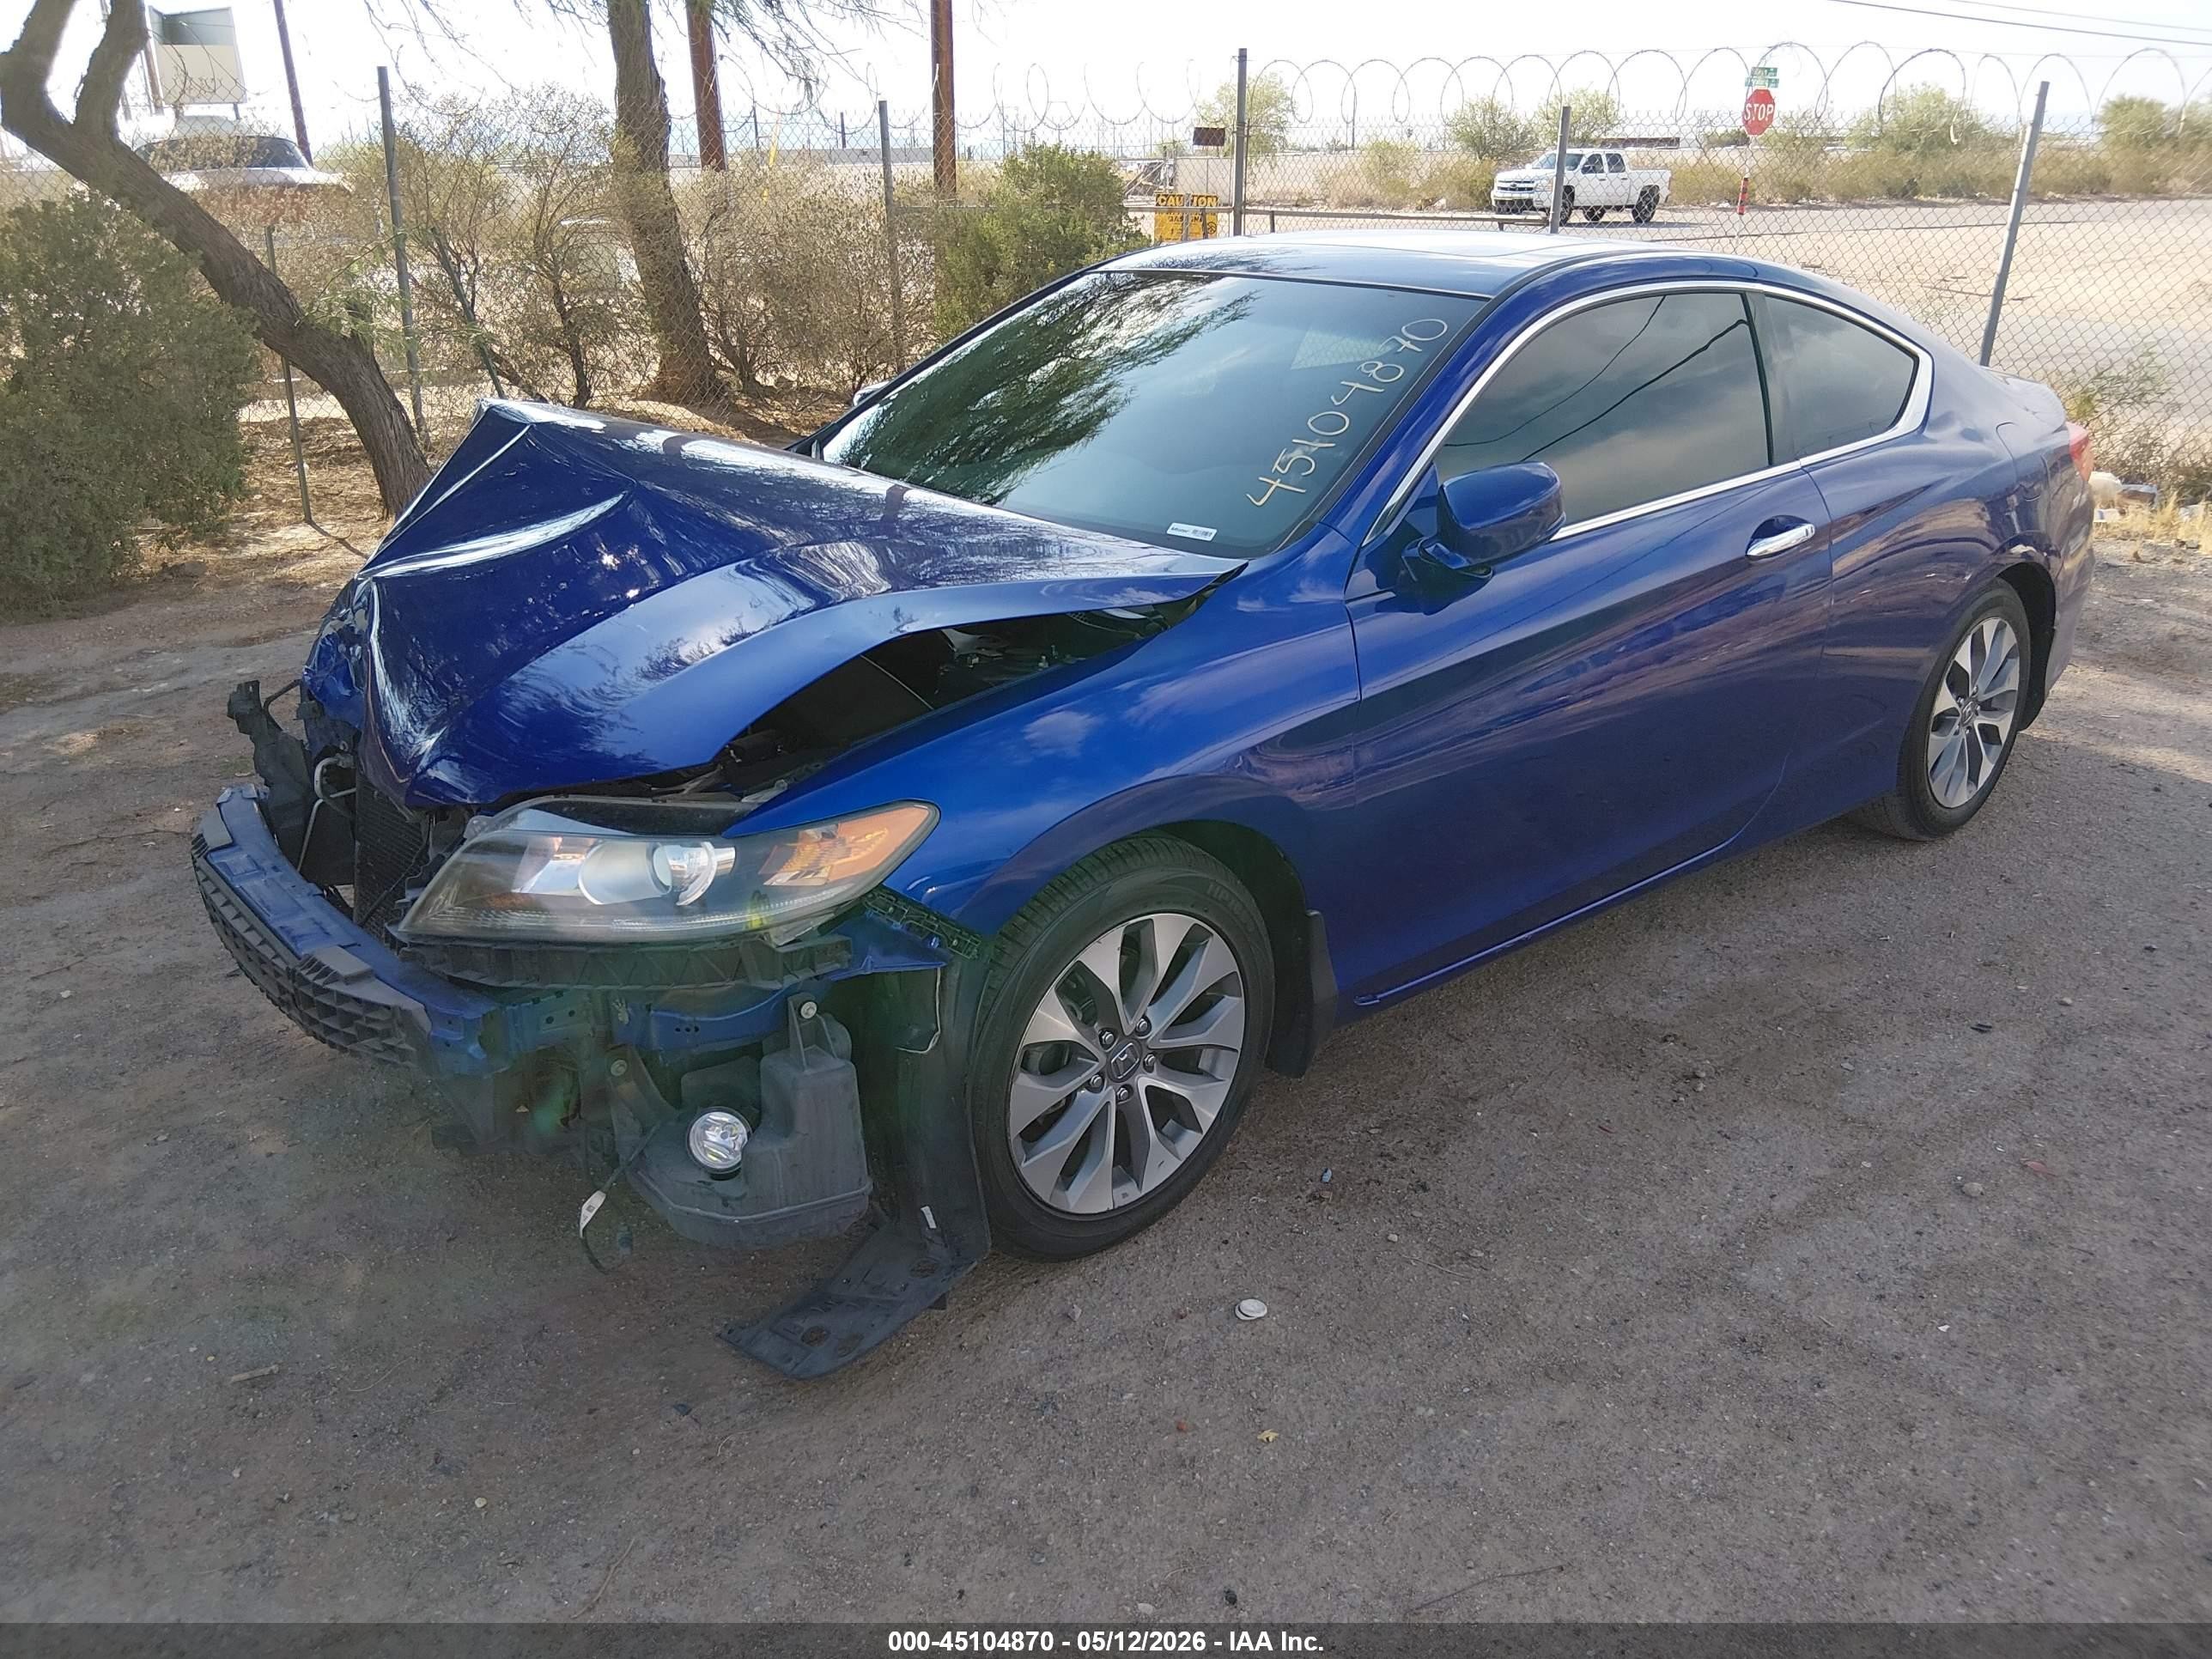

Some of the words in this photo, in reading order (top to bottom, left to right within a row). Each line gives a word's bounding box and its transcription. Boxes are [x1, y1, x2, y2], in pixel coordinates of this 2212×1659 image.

[1744, 103, 1774, 122] STOP
[1158, 195, 1218, 207] CAUION
[1245, 318, 1449, 507] 45104870
